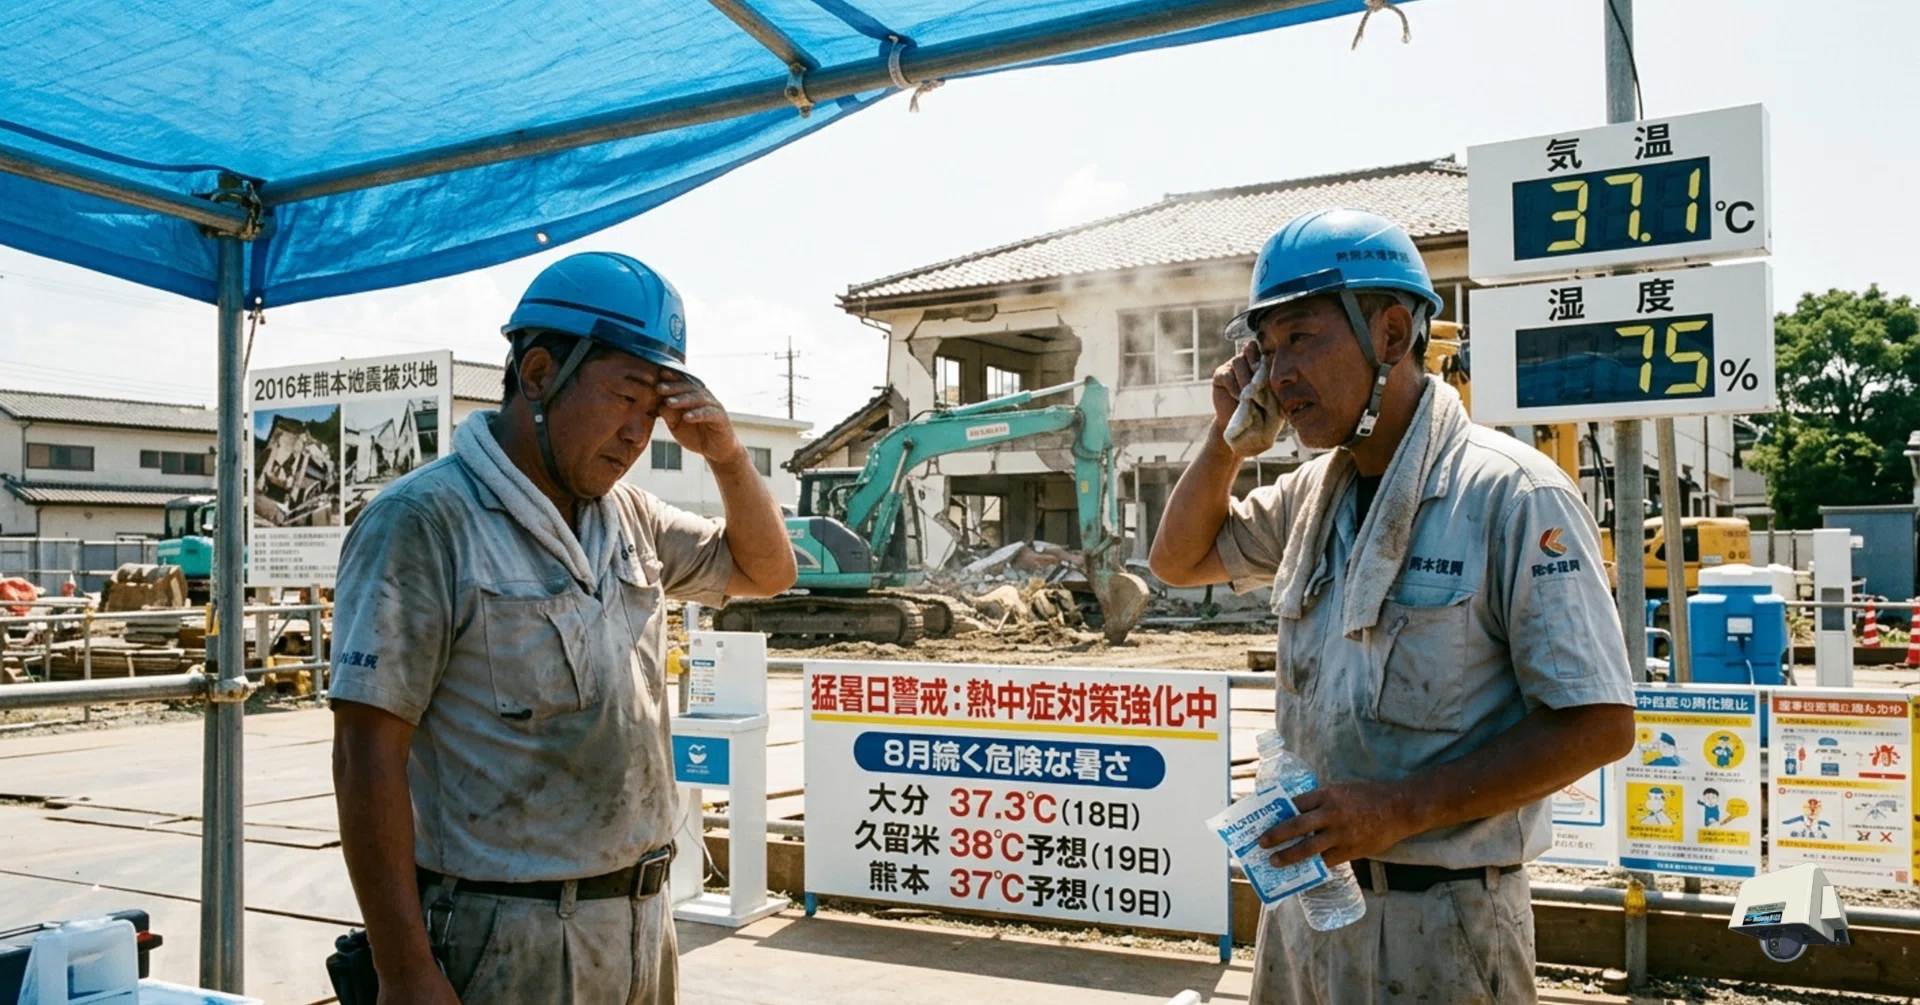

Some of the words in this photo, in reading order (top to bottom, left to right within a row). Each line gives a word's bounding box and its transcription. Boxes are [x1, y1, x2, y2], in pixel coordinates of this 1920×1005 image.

[1615, 320, 1709, 395] 75
[884, 739, 1131, 782] 8月続く危険な暑さ
